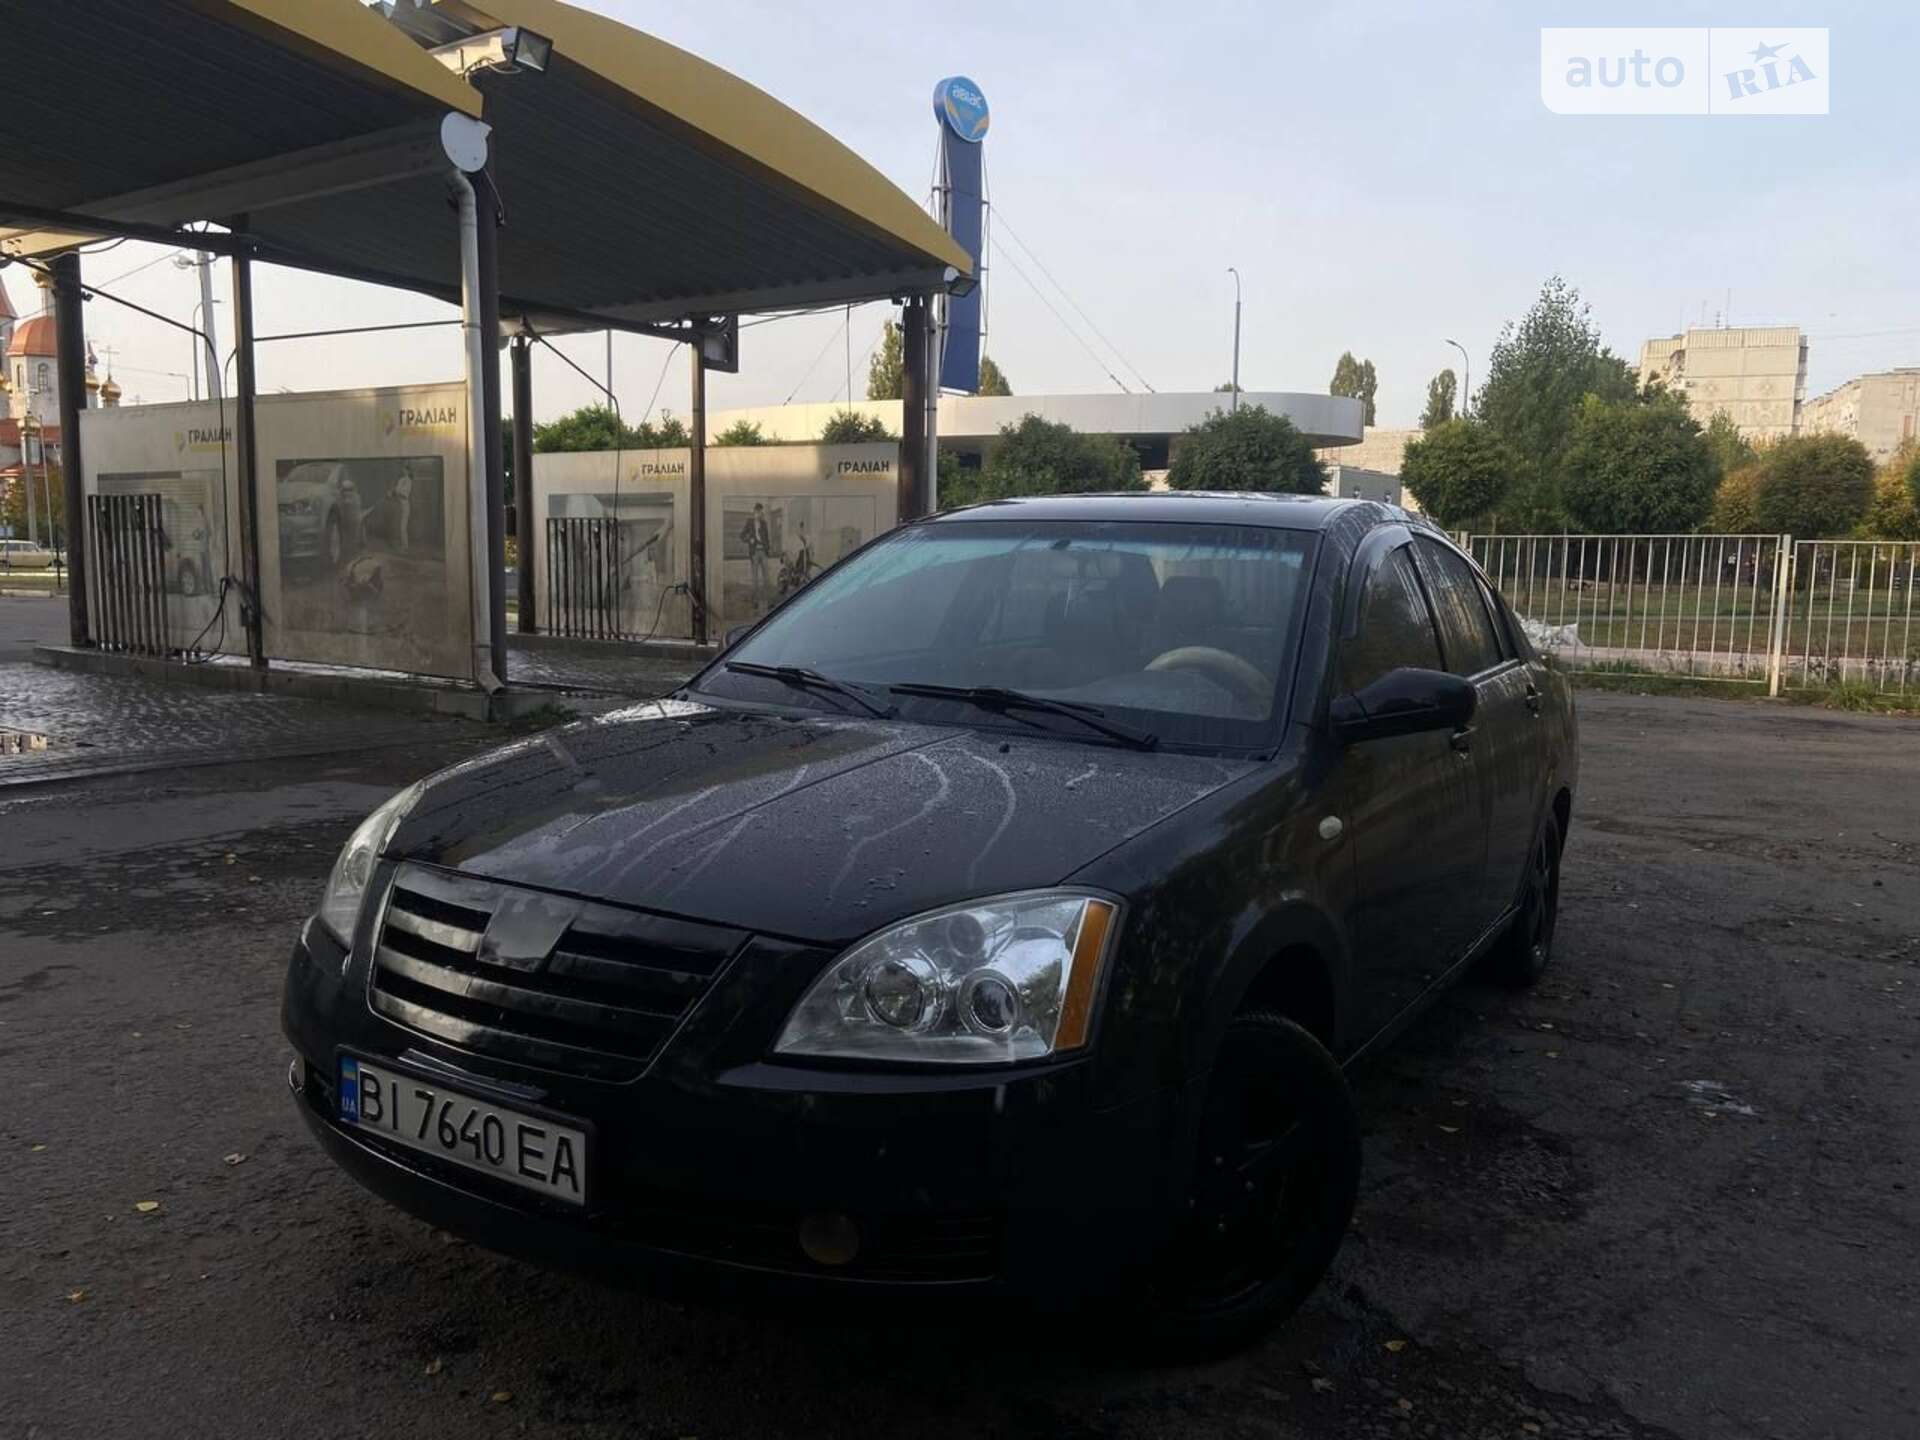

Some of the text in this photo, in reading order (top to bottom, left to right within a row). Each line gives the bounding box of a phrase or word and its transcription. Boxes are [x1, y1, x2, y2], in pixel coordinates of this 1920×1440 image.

[399, 407, 457, 425] ГРАЛІАН
[641, 463, 685, 474] ГРАЛІАН
[838, 460, 889, 473] ГРАЛІАН
[341, 1095, 357, 1113] UA
[360, 1068, 580, 1193] BI 7640 EA
